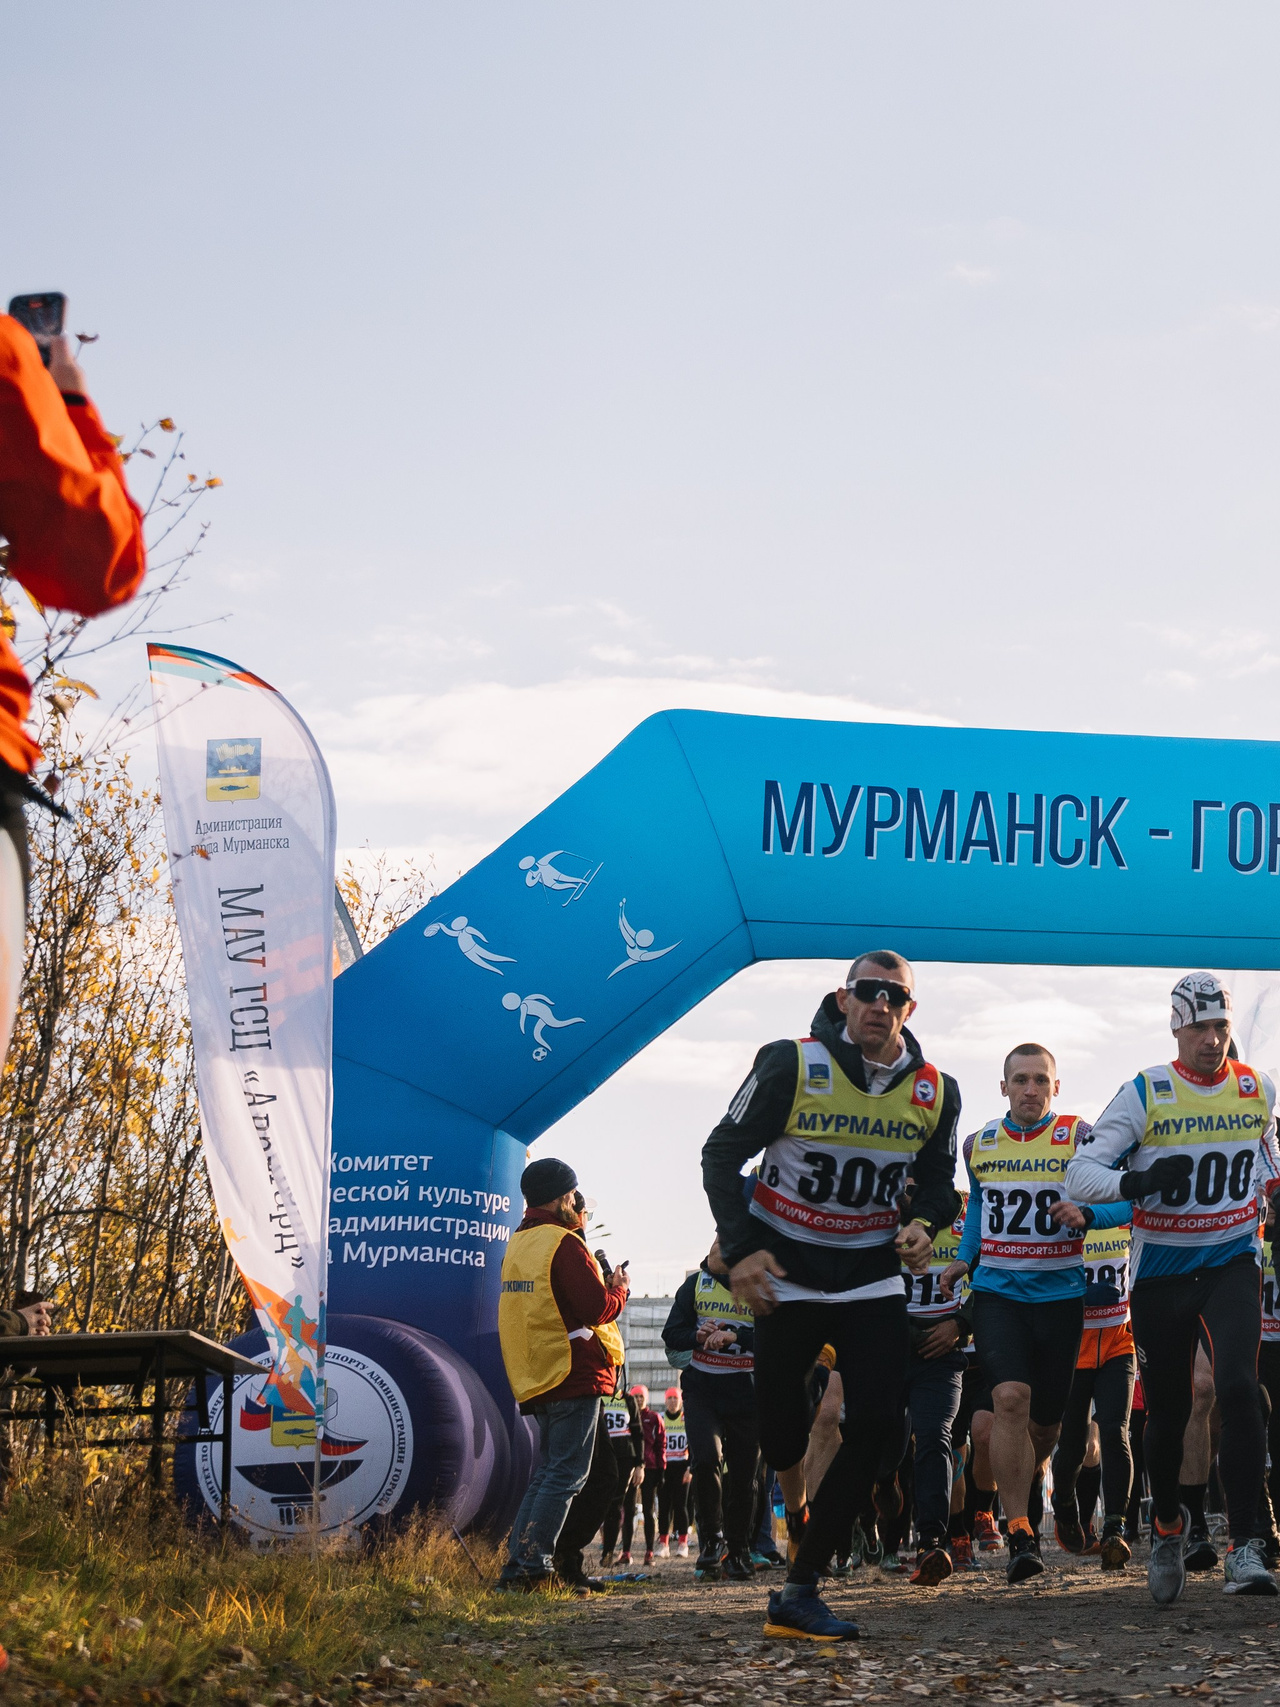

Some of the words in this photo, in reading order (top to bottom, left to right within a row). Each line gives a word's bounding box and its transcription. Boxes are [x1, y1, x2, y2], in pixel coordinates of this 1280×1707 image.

[762, 780, 1130, 870] МУРМАНСК
[1149, 828, 1172, 839] -
[223, 837, 290, 854] Мурманска
[218, 884, 266, 968] МАУ
[229, 982, 272, 1052] ГСЦ
[798, 1112, 928, 1141] МУРМАНСК
[1154, 1113, 1263, 1136] МУРМАНСК
[330, 1152, 433, 1173] Комитет
[976, 1158, 1071, 1174] МУРМАНСК
[328, 1179, 409, 1202] еской
[419, 1185, 511, 1215] культуре
[987, 1189, 1062, 1236] 328
[328, 1216, 511, 1242] администрации
[343, 1241, 486, 1268] Мурманска
[695, 1300, 755, 1316] МУРМАНС
[325, 1351, 369, 1371] СПОРТУ
[367, 1369, 406, 1464] АДМИНИСТРАЦИИ
[604, 1412, 626, 1430] 65
